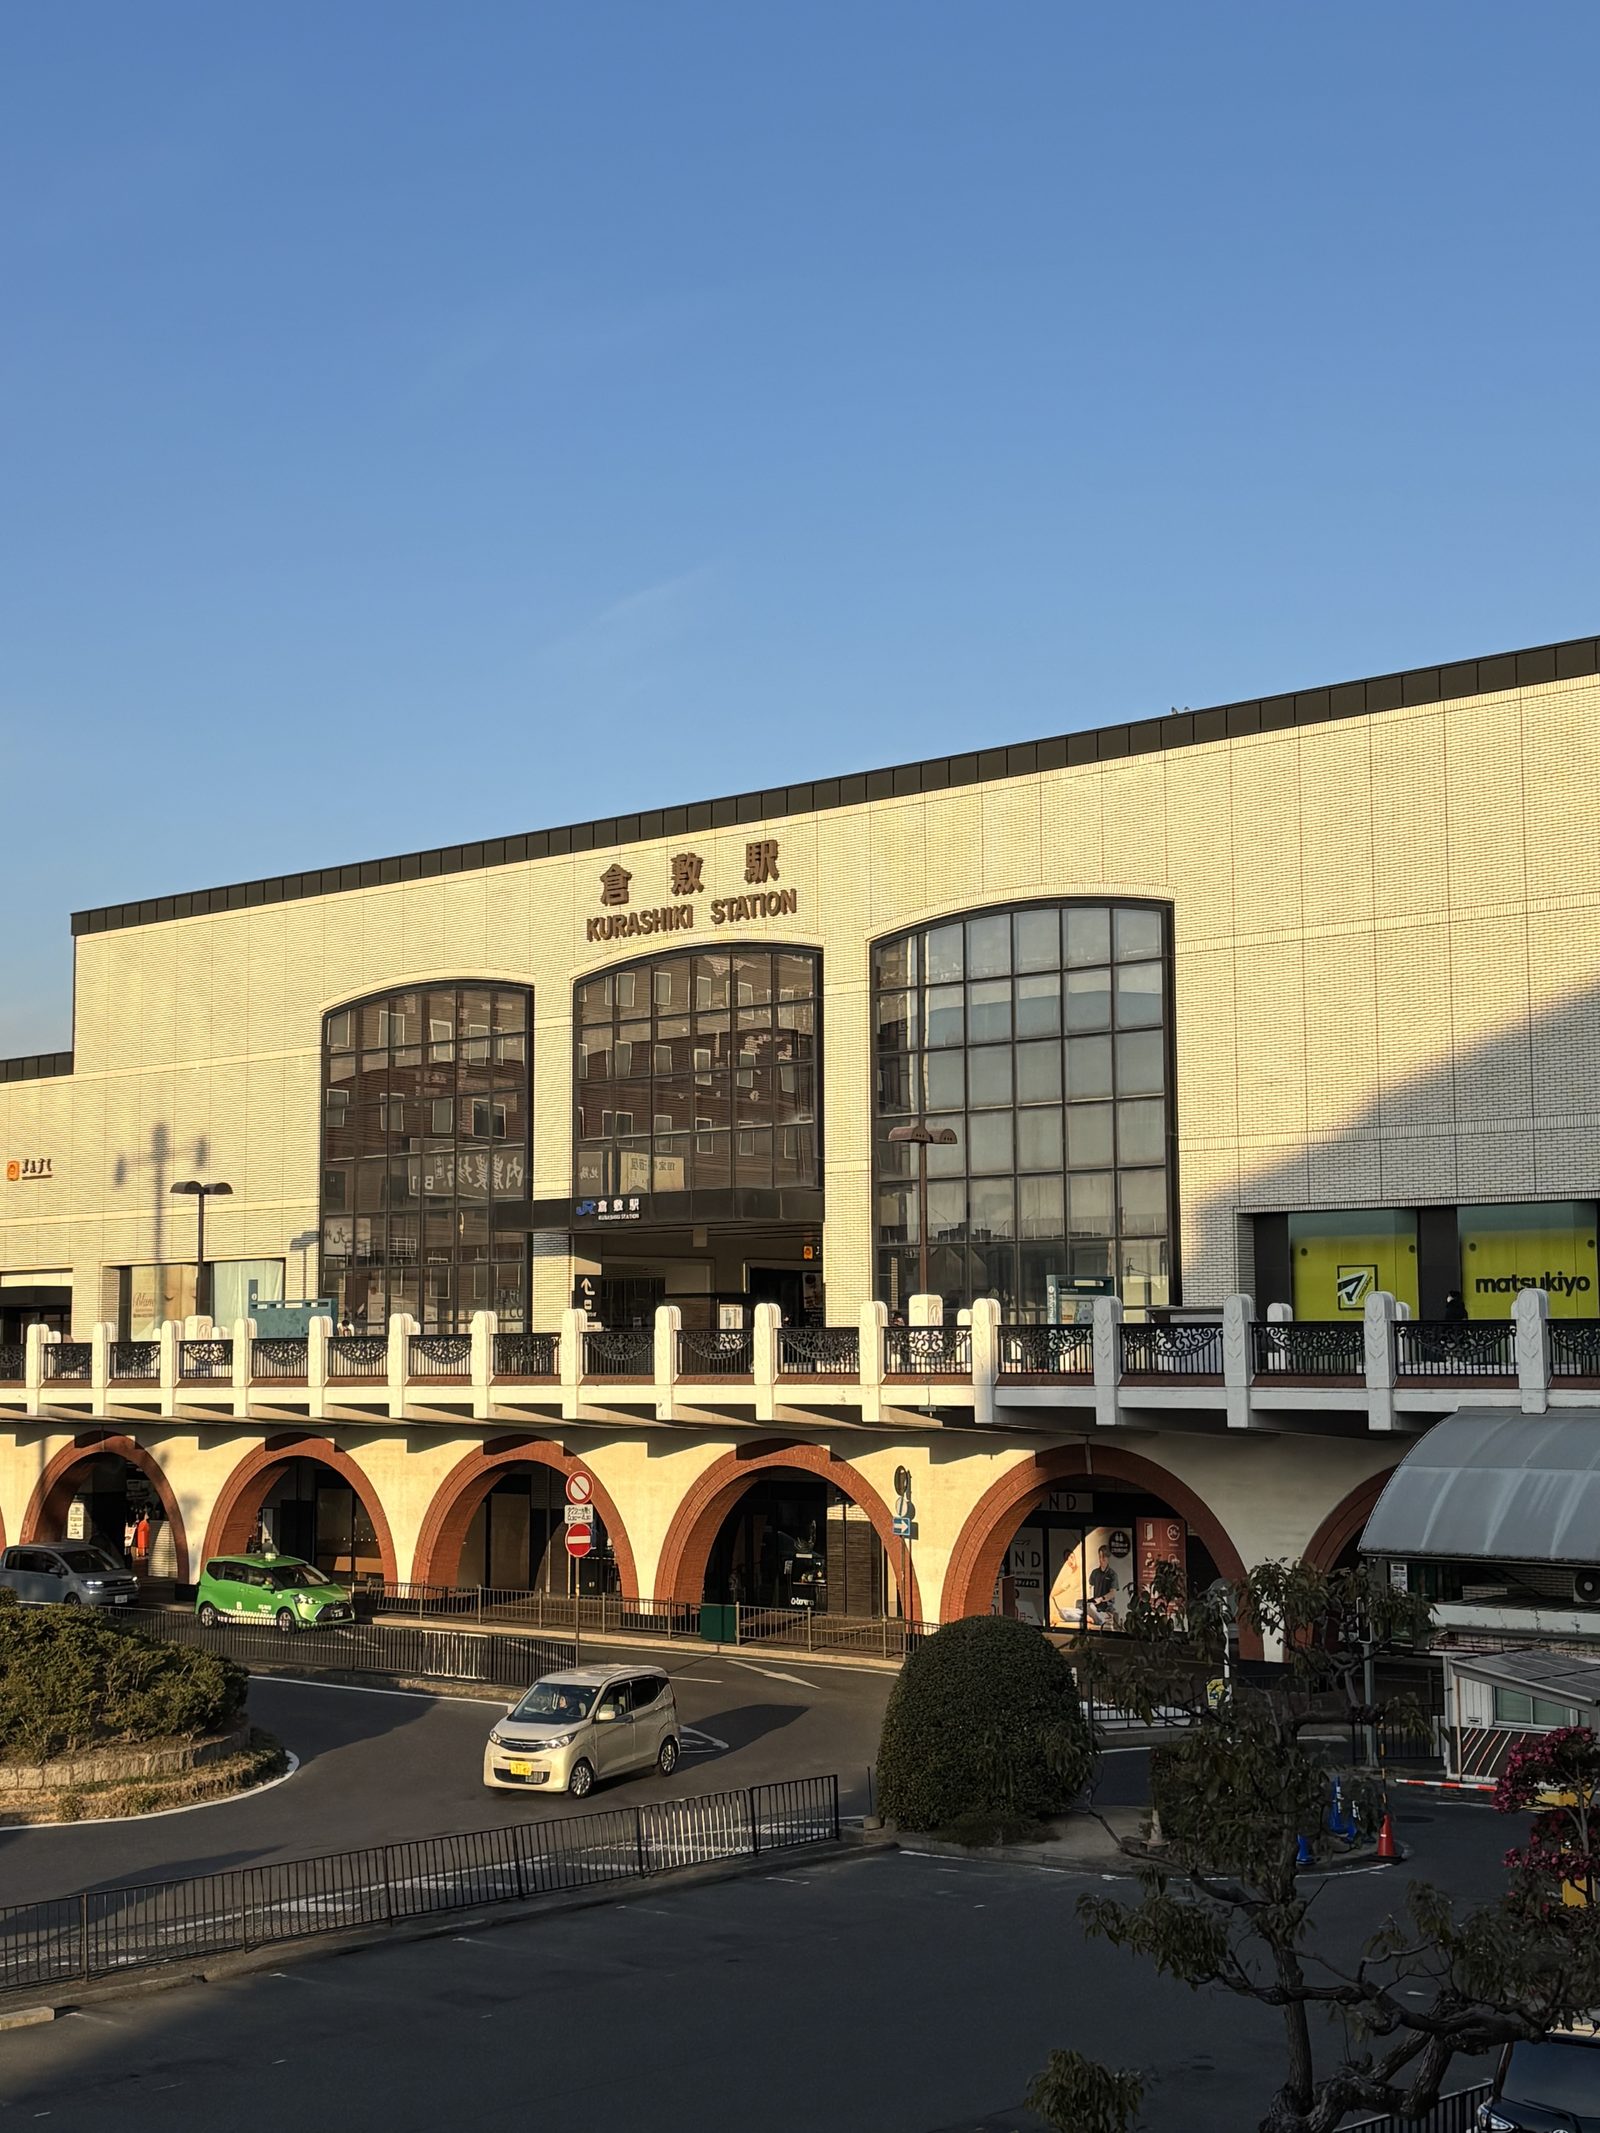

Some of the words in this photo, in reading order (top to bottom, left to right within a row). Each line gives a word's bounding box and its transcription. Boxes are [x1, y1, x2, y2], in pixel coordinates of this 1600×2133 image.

[600, 839, 779, 906] 倉敷駅
[586, 904, 694, 942] KURASHIKI
[711, 888, 797, 924] STATION
[576, 1200, 597, 1216] JR
[1475, 1271, 1591, 1297] matsukiyo
